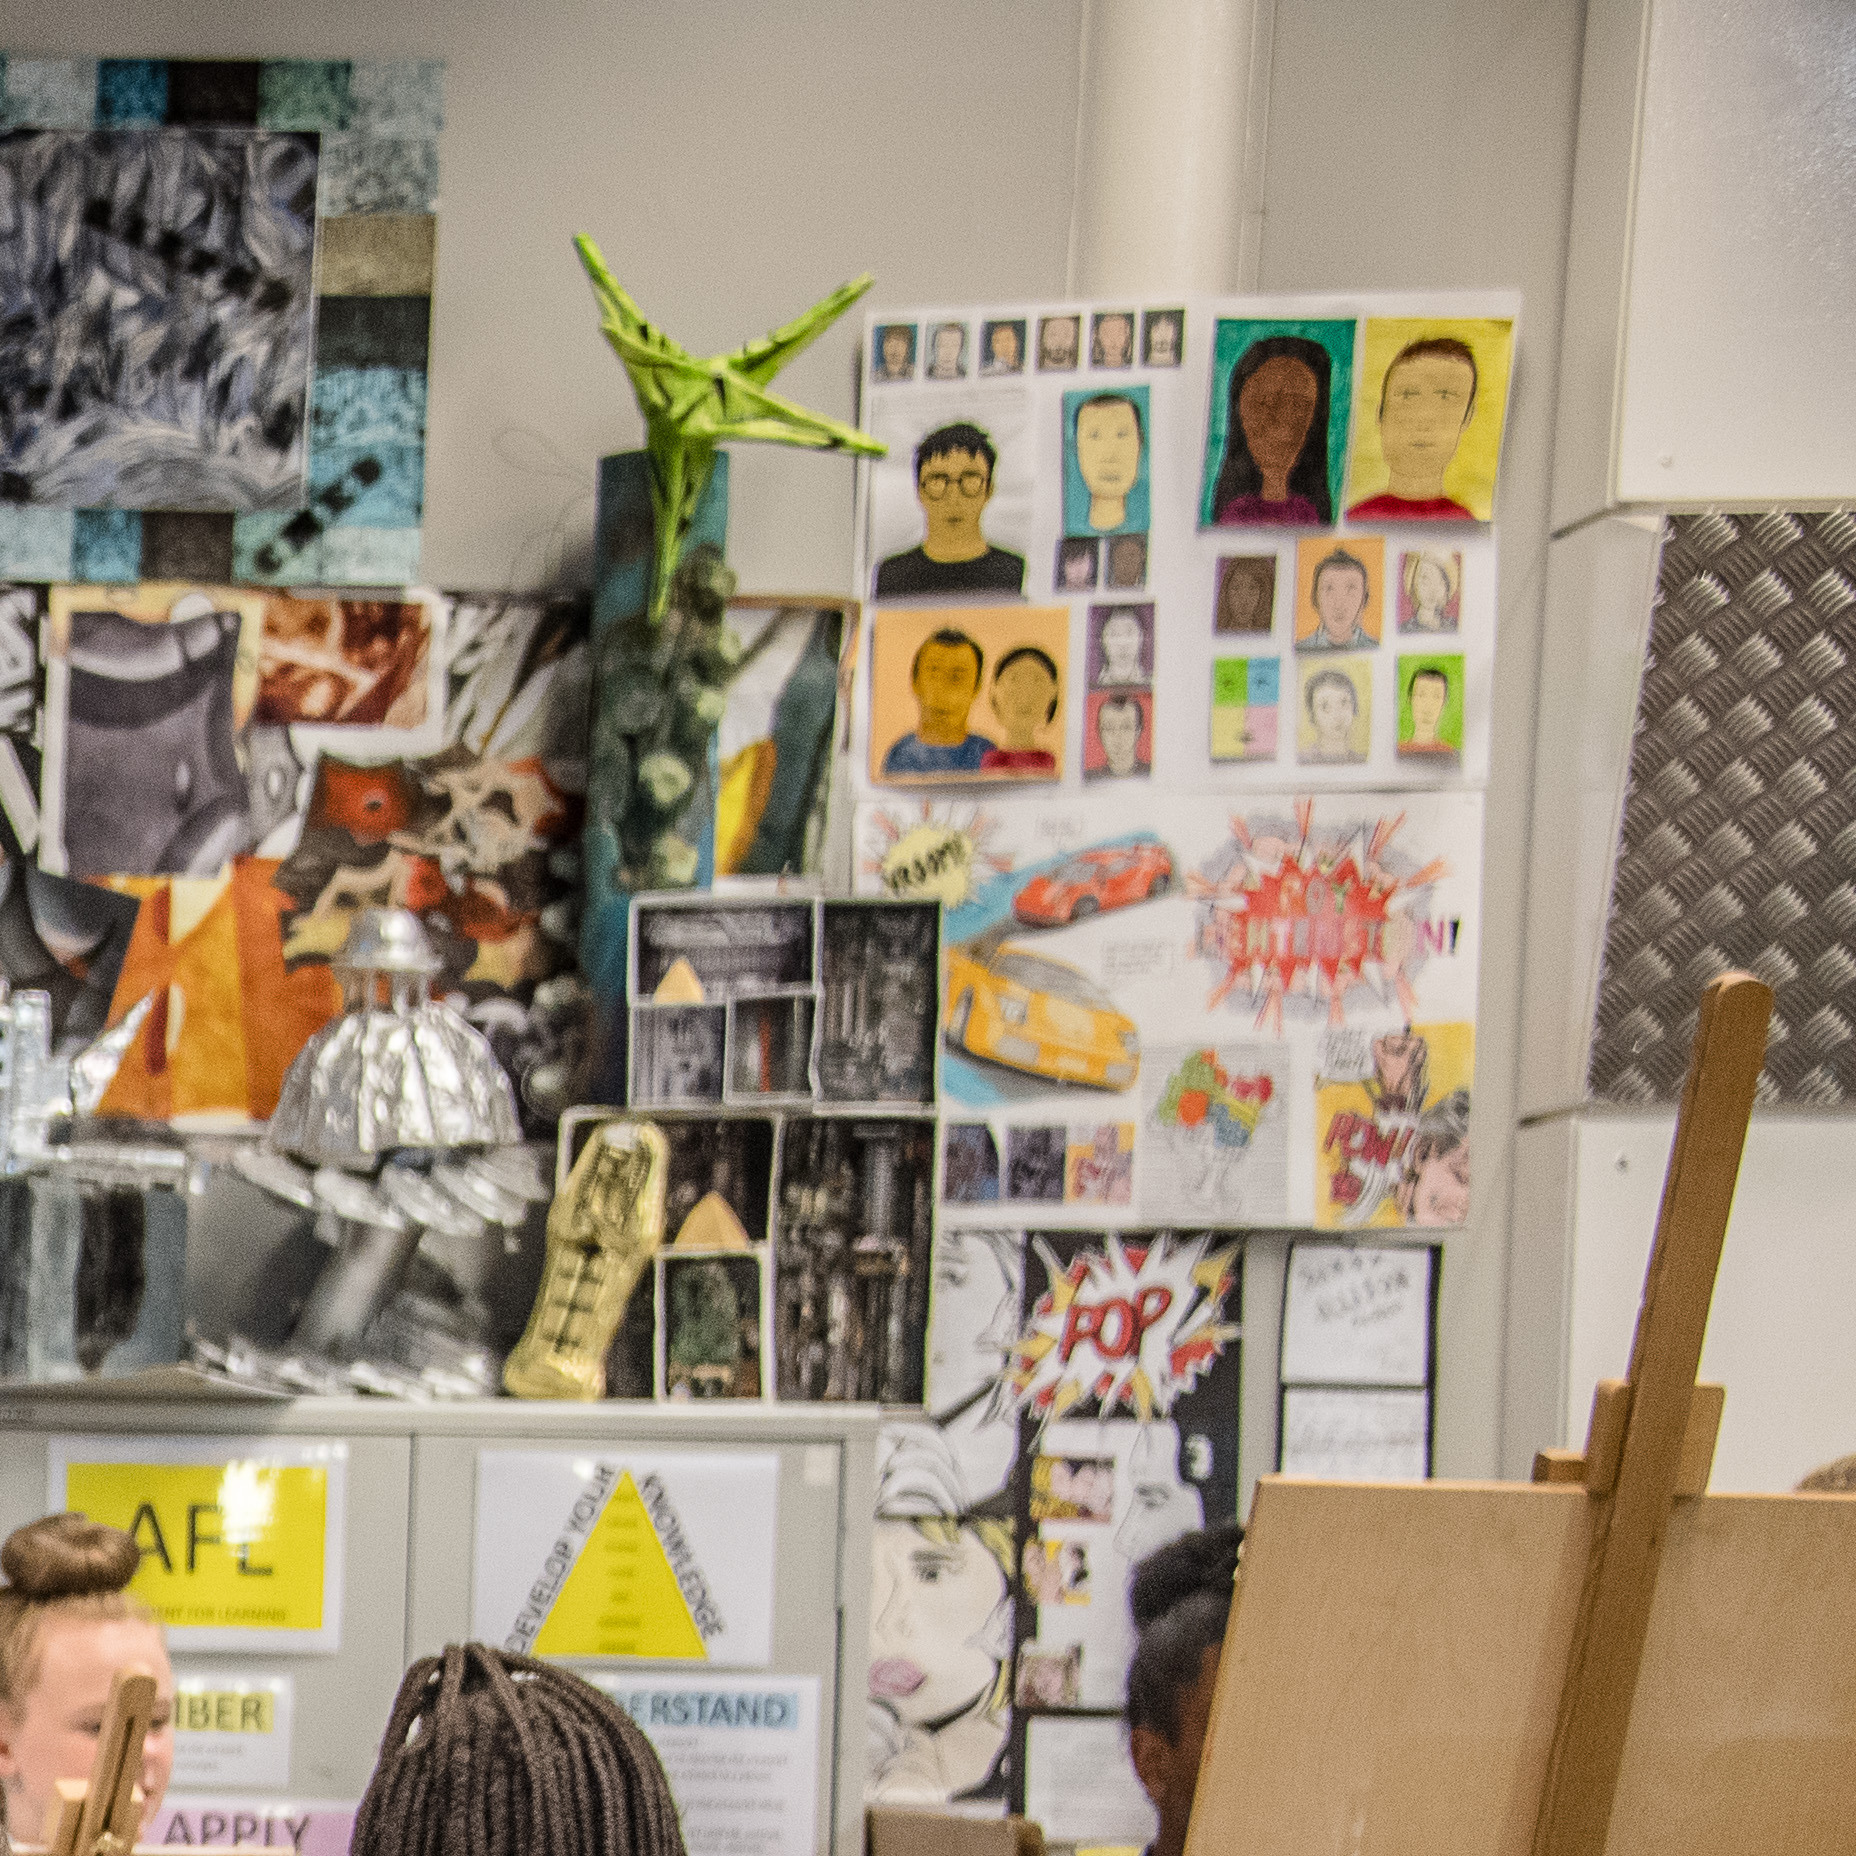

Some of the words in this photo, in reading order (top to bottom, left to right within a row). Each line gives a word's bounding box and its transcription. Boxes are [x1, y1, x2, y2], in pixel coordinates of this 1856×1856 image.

[1059, 1286, 1172, 1364] POP
[502, 1537, 573, 1656] DEVELOP
[570, 1461, 616, 1536] YOUR
[639, 1472, 725, 1640] KNOWLEDGE
[164, 1812, 310, 1850] APPLY
